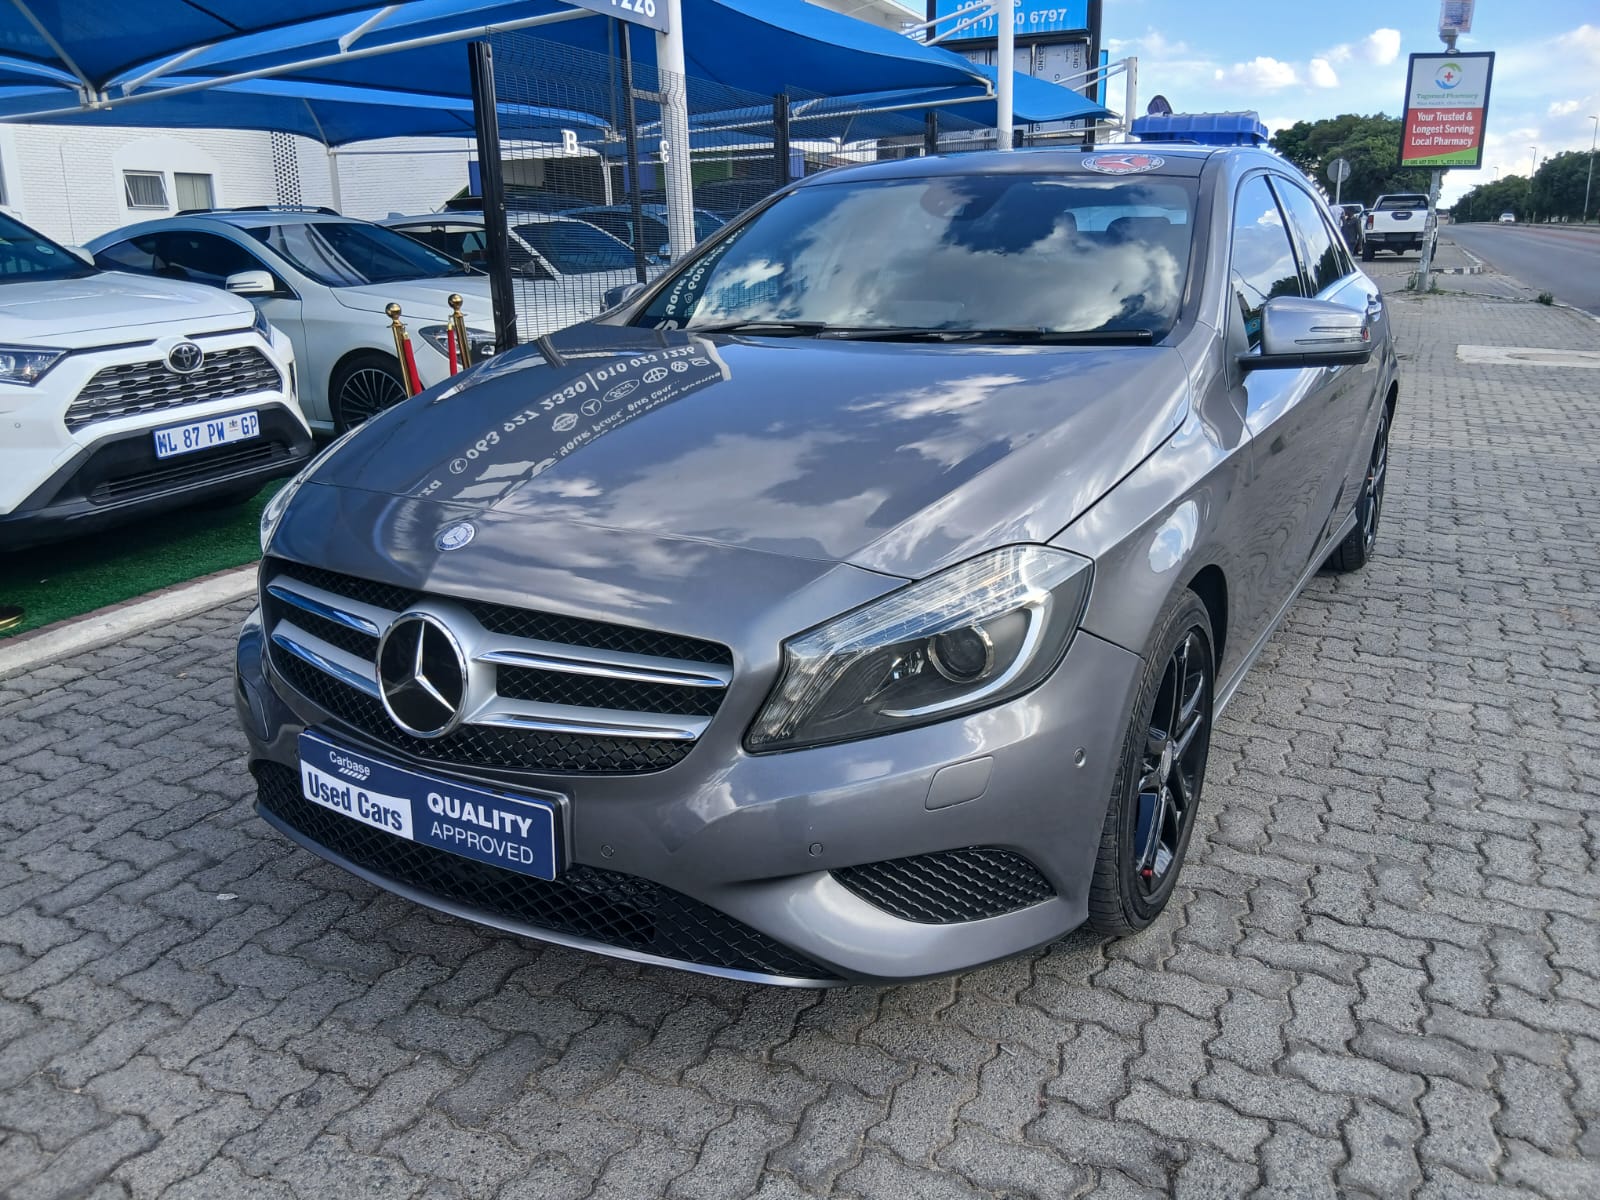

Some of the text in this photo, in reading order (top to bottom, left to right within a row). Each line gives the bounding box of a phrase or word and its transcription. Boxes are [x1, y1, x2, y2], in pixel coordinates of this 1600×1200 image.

[1029, 8, 1067, 24] 6797
[1417, 112, 1473, 121] Your Trusted &
[1411, 137, 1473, 147] Local Pharmacy
[1412, 125, 1475, 135] Longest Serving
[183, 426, 200, 449] 87
[207, 421, 226, 444] PW
[240, 415, 257, 435] GP
[329, 751, 371, 777] Carbase
[308, 771, 403, 831] Used Cars
[427, 792, 533, 838] QUALITY
[431, 821, 534, 865] APPROVED
